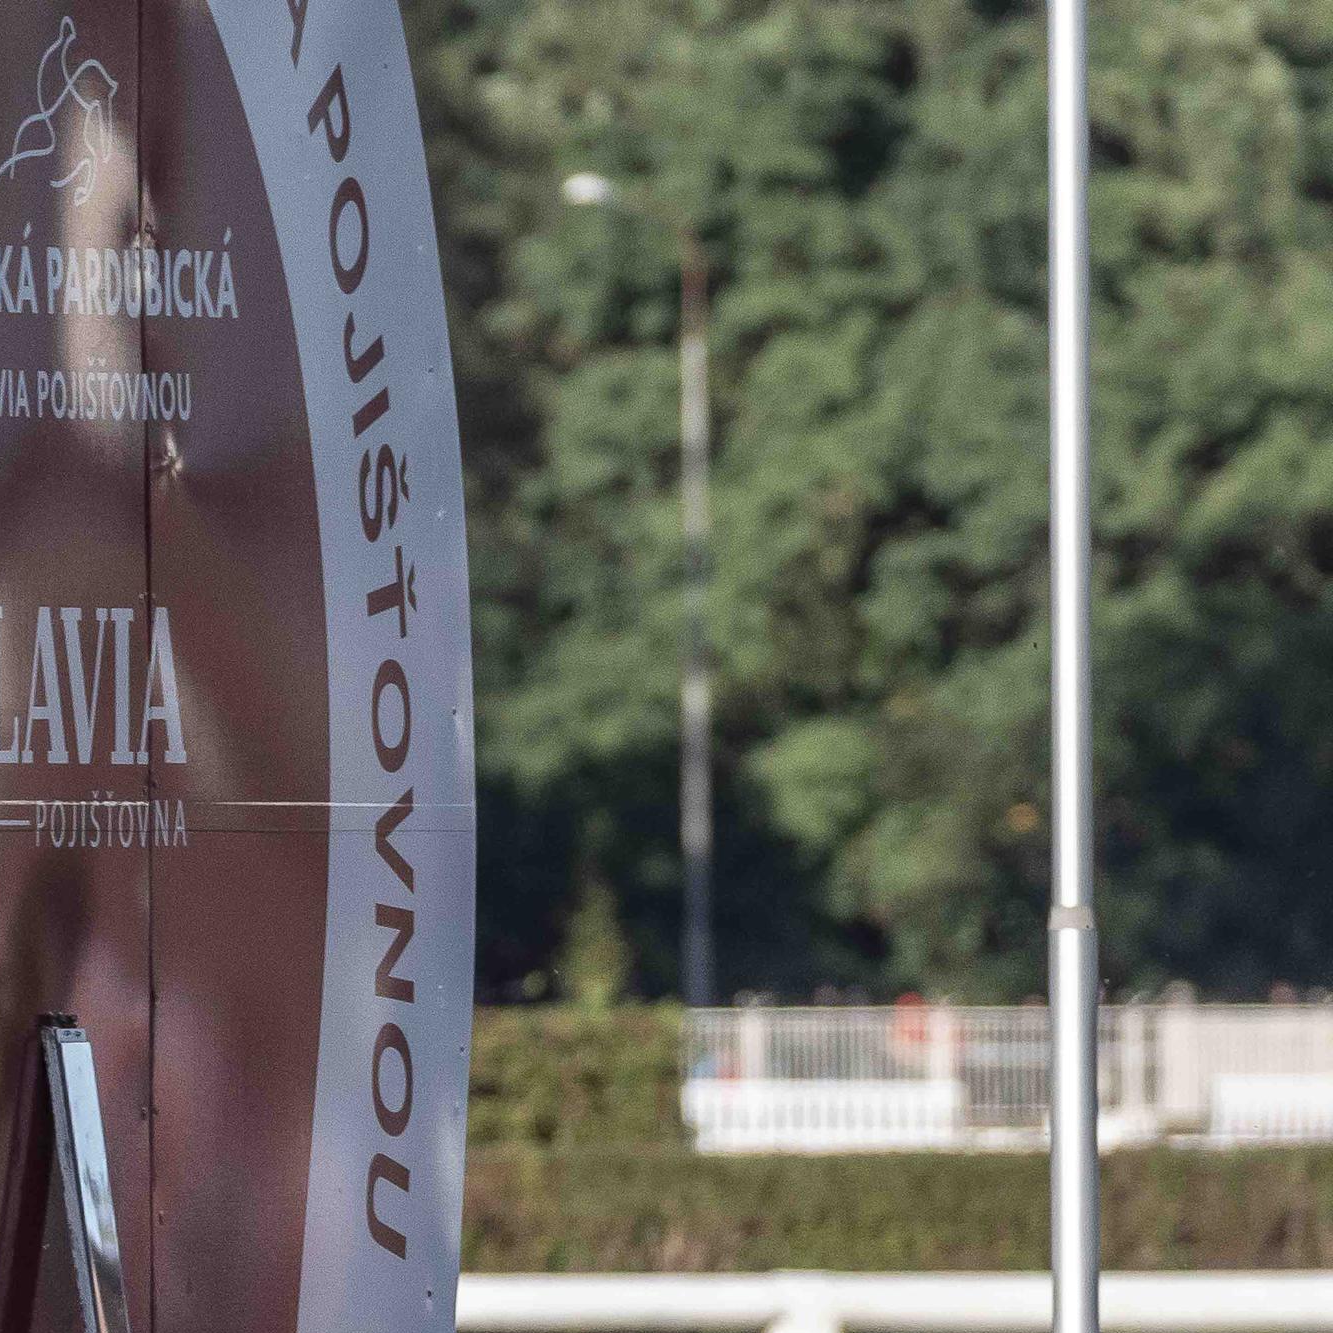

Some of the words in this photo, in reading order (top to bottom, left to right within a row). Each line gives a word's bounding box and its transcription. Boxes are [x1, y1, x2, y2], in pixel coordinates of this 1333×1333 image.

[46, 227, 239, 319] PARDUBICKÁ
[37, 356, 192, 421] POJIŠŤOVNOU
[307, 62, 419, 1260] POJIŠŤOVNOU
[35, 790, 188, 849] POJIŠŤOVNA
